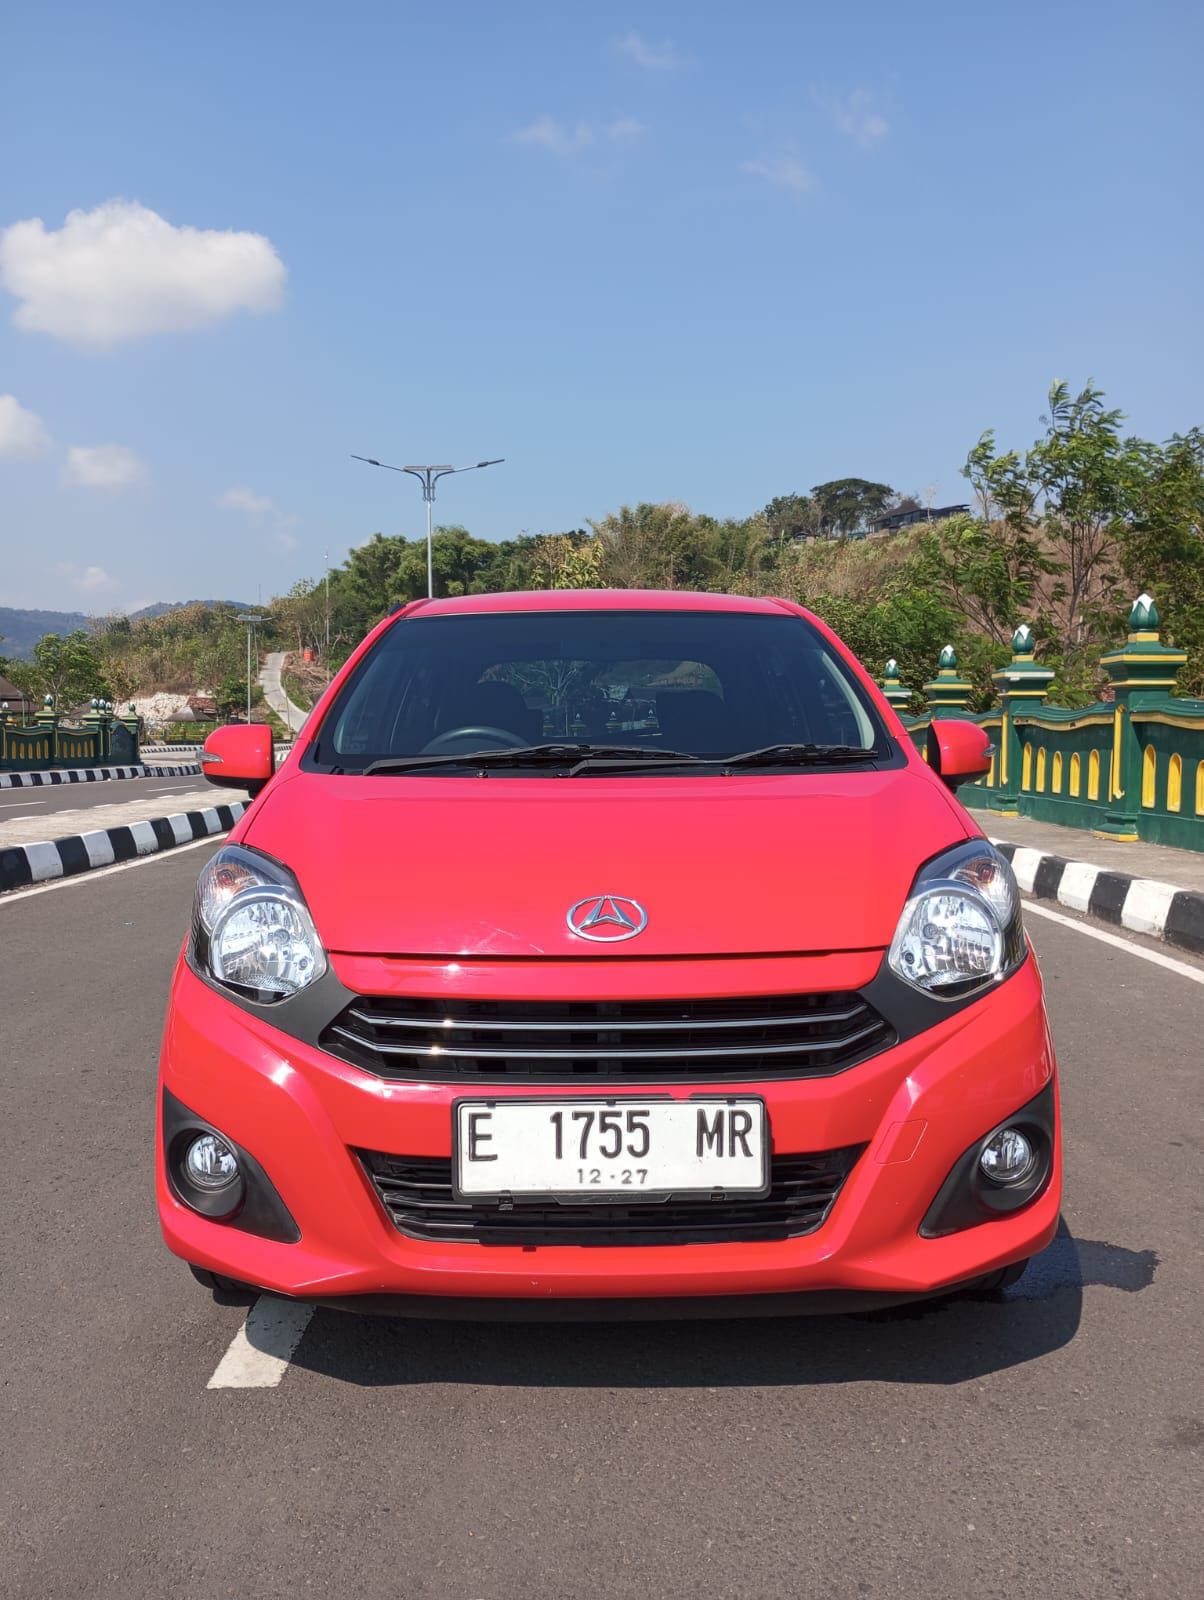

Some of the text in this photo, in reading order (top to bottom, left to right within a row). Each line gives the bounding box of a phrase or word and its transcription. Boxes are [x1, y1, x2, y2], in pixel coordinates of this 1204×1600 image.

[468, 1108, 754, 1162] E 1755 MR
